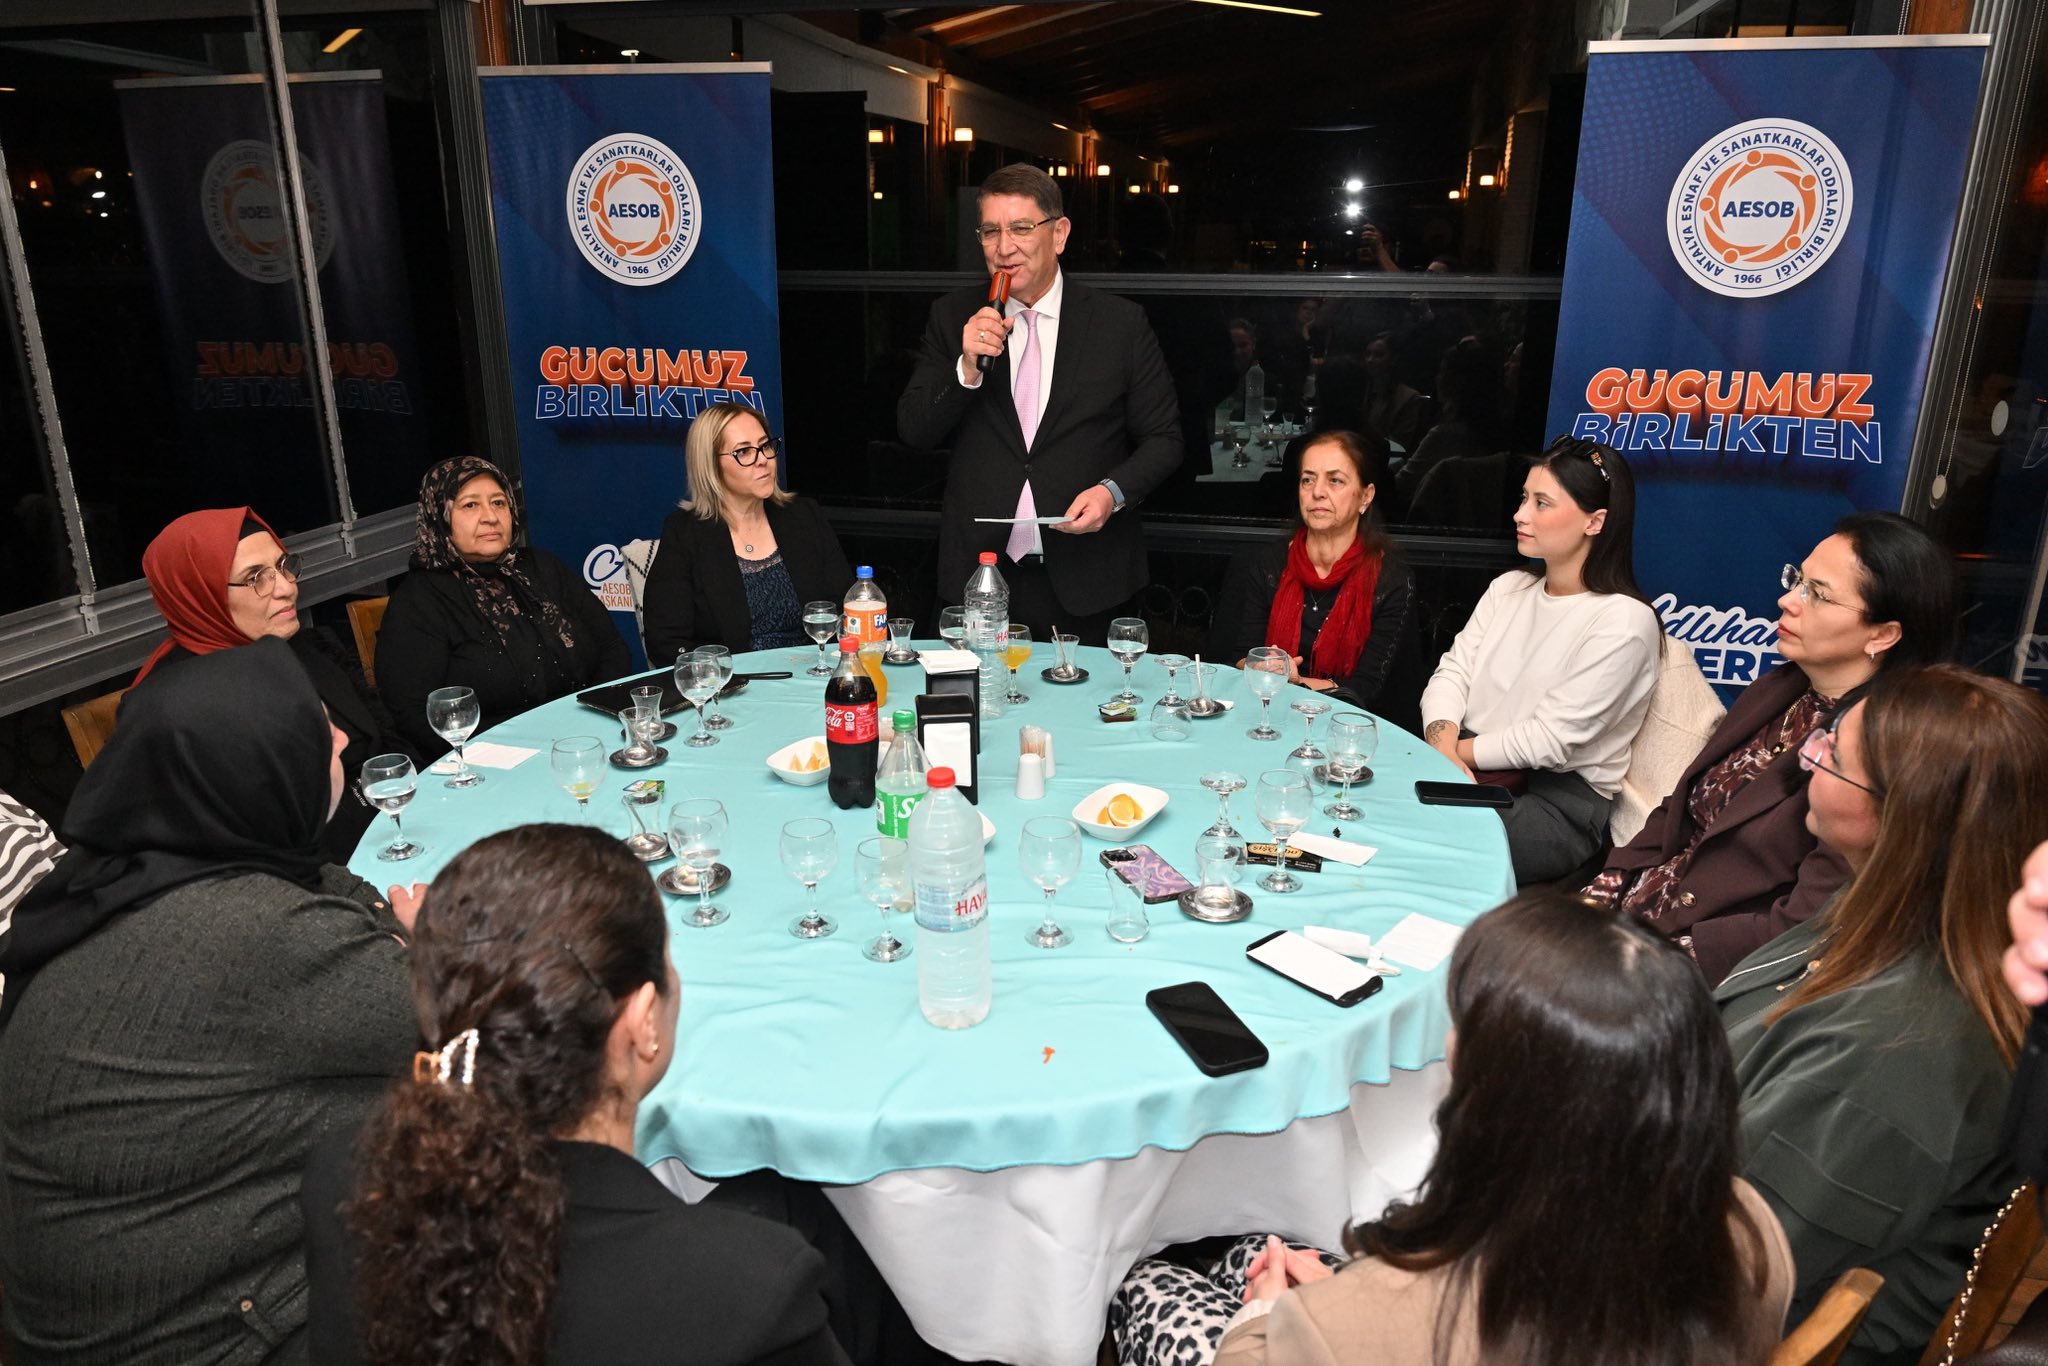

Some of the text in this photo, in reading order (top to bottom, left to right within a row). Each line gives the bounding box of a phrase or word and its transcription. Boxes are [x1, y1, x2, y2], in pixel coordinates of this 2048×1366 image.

[584, 165, 597, 178] VE
[596, 145, 673, 174] SANATKARLAR
[577, 181, 588, 220] ESNAF
[608, 203, 660, 218] AESOB
[672, 174, 691, 230] ODALARI
[1681, 132, 1838, 280] ANTALYA ESNAF VE SANATKARLAR ODALARI BİRLİĞİ
[1722, 201, 1795, 218] AESOB
[581, 224, 619, 268] ANTALYA
[627, 265, 649, 274] 1966
[1734, 274, 1762, 284] 1966
[540, 346, 754, 388] GÜCÜMÜZ
[1586, 367, 1874, 417] GÜCÜMÜZ
[602, 583, 632, 595] AESOB
